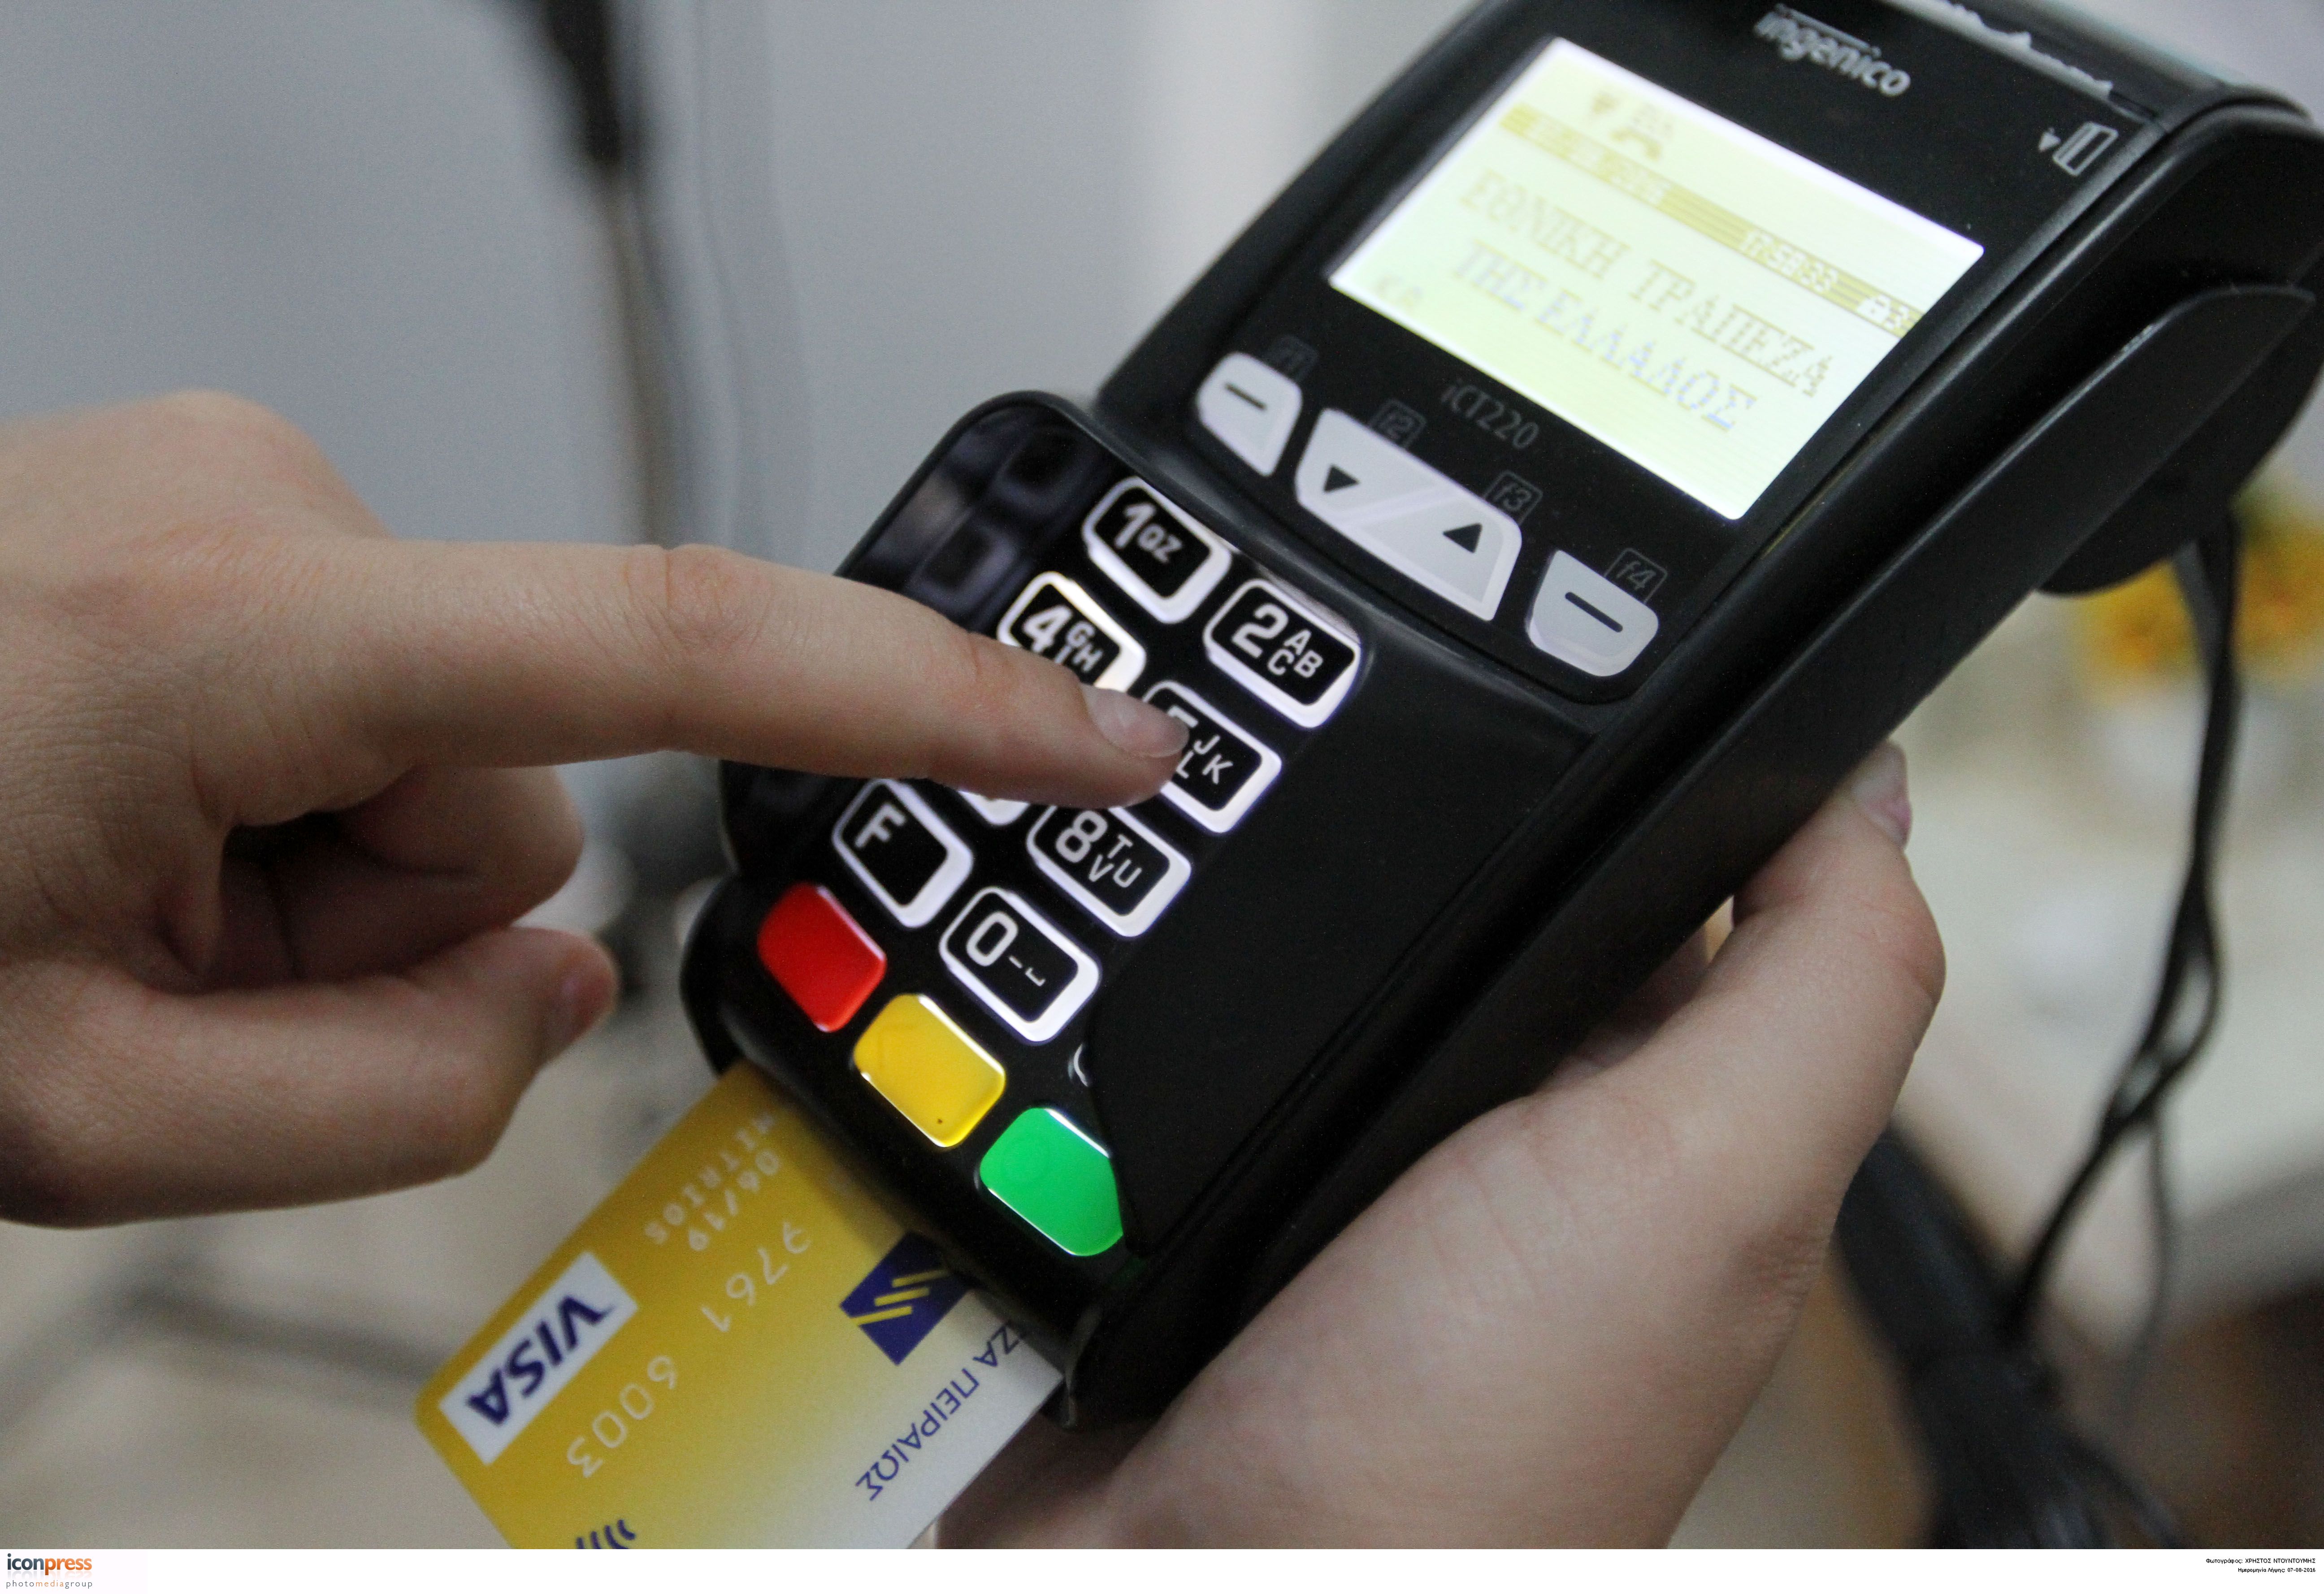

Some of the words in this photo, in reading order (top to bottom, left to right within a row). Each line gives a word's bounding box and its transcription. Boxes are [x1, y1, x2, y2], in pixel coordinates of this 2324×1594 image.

[1753, 3, 1911, 97] ingenico
[1538, 288, 1759, 432] ΕΛΛΑΔΟΣ
[1628, 259, 1833, 397] ΤΡΑΠΕΖΑ
[1440, 378, 1539, 448] iCT220
[1495, 484, 1532, 511] f3
[1616, 561, 1656, 590] f4
[855, 802, 906, 849] F
[688, 1148, 781, 1252] 06/19
[700, 1220, 812, 1334] 9761
[465, 1292, 616, 1428] VISA
[566, 1354, 679, 1478] 6003
[855, 1367, 980, 1501] ΠΕΙΡΑΙΩΣ
